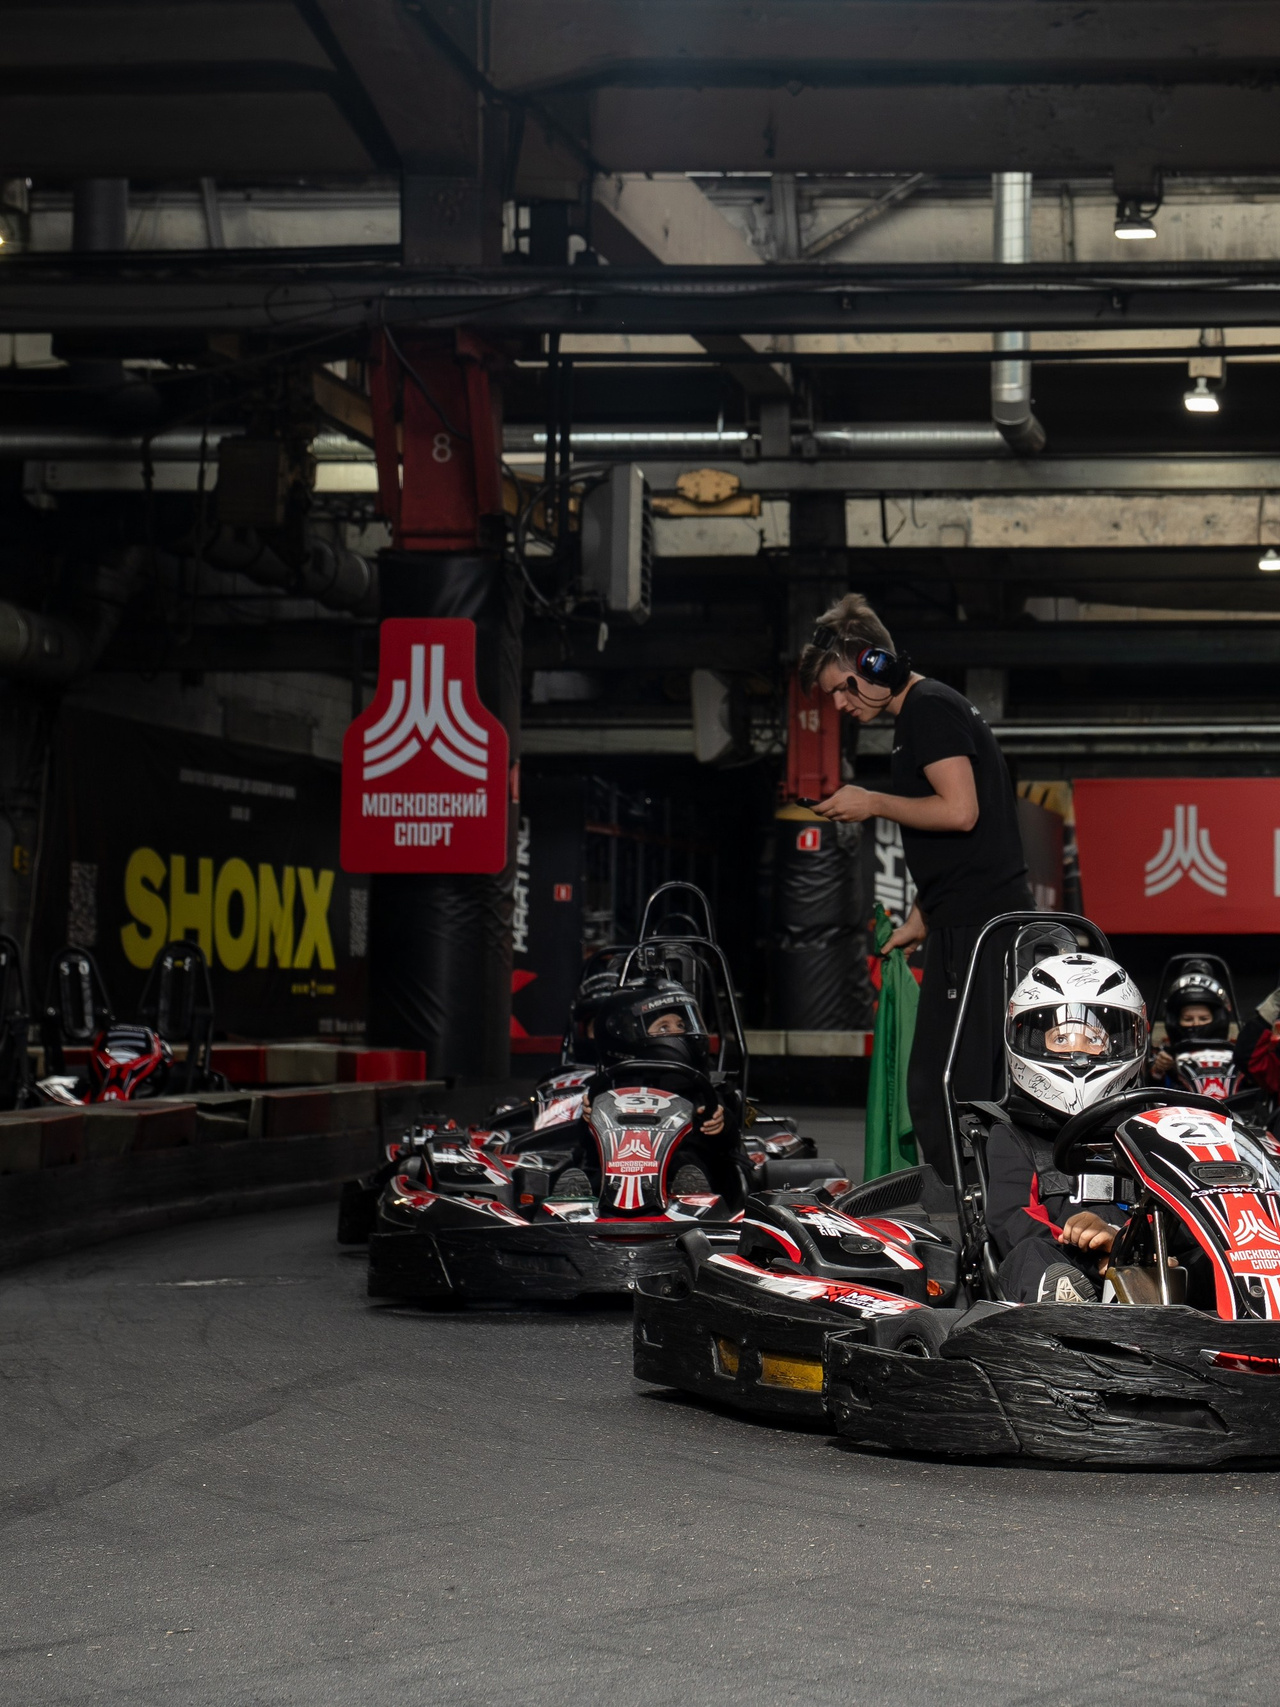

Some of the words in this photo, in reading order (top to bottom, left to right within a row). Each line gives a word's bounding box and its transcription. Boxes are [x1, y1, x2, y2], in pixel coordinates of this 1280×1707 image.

[432, 433, 452, 463] 8
[361, 787, 488, 818] МОСКОВСКИЙ
[393, 821, 454, 847] СПОРТ
[120, 846, 336, 972] SHONX
[625, 1096, 660, 1107] 31
[608, 1160, 659, 1168] МОСКОВСКИЙ
[1191, 1187, 1265, 1199] АЭРОФЛОТ
